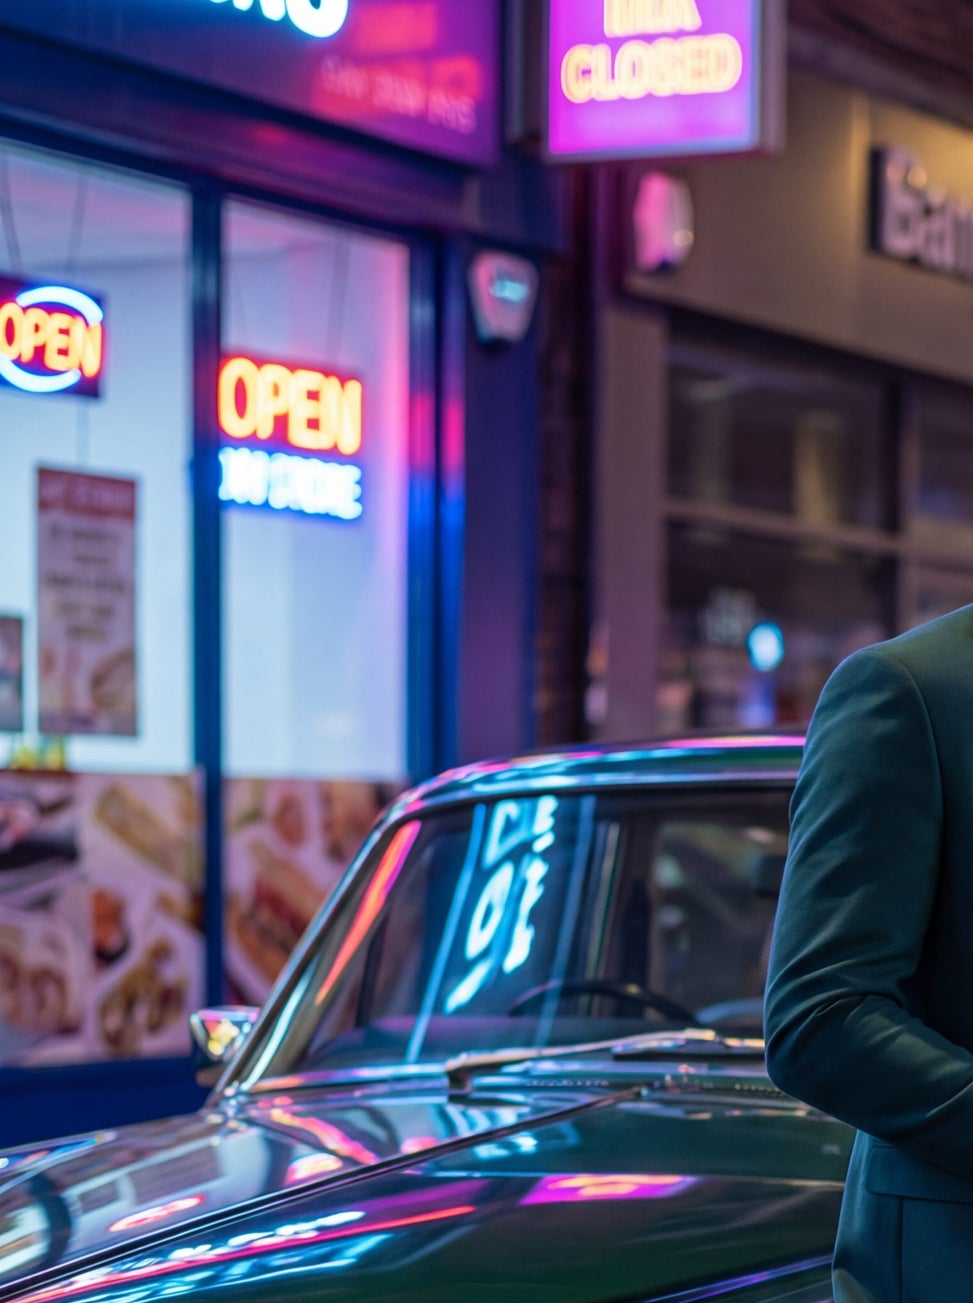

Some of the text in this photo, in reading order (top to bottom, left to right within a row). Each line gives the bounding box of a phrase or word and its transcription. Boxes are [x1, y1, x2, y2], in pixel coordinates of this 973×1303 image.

[561, 33, 742, 103] CLOSED
[0, 302, 102, 377] OPEN
[218, 357, 362, 456] OPEN
